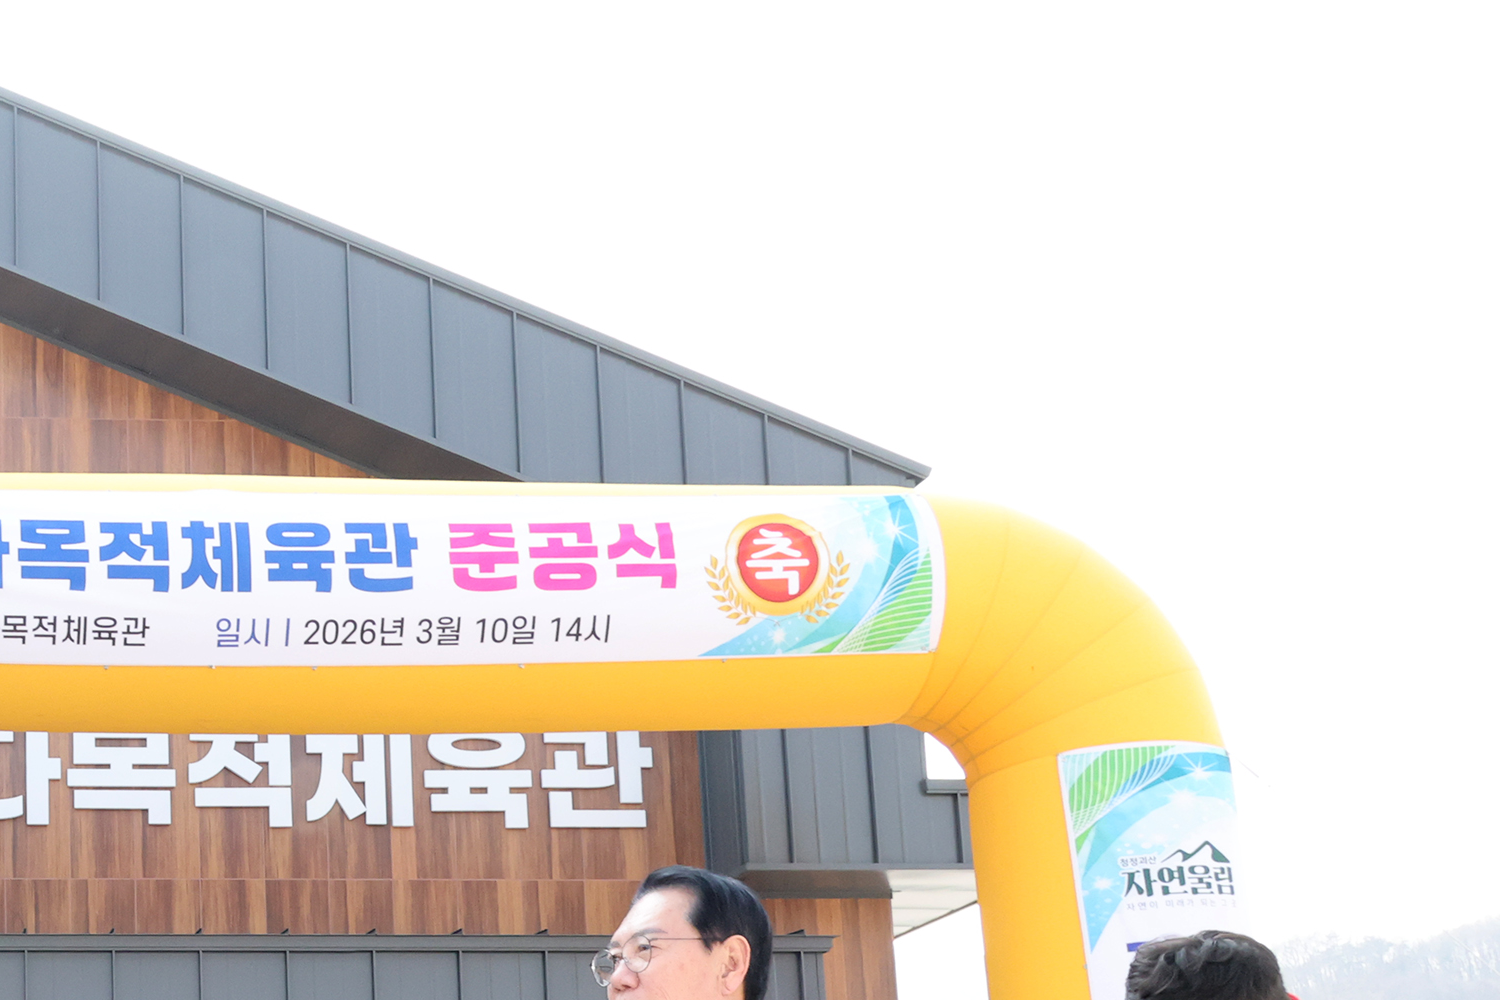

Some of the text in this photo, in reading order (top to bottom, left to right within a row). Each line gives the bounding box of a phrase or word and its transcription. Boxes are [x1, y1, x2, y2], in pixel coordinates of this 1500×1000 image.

[447, 521, 679, 592] 준공식
[750, 526, 810, 596] 축
[215, 617, 270, 648] 일시
[303, 616, 405, 647] 2026년
[415, 616, 462, 646] 3월
[476, 616, 537, 646] 10일
[550, 615, 612, 645] 14시
[1121, 864, 1236, 898] 자연울림
